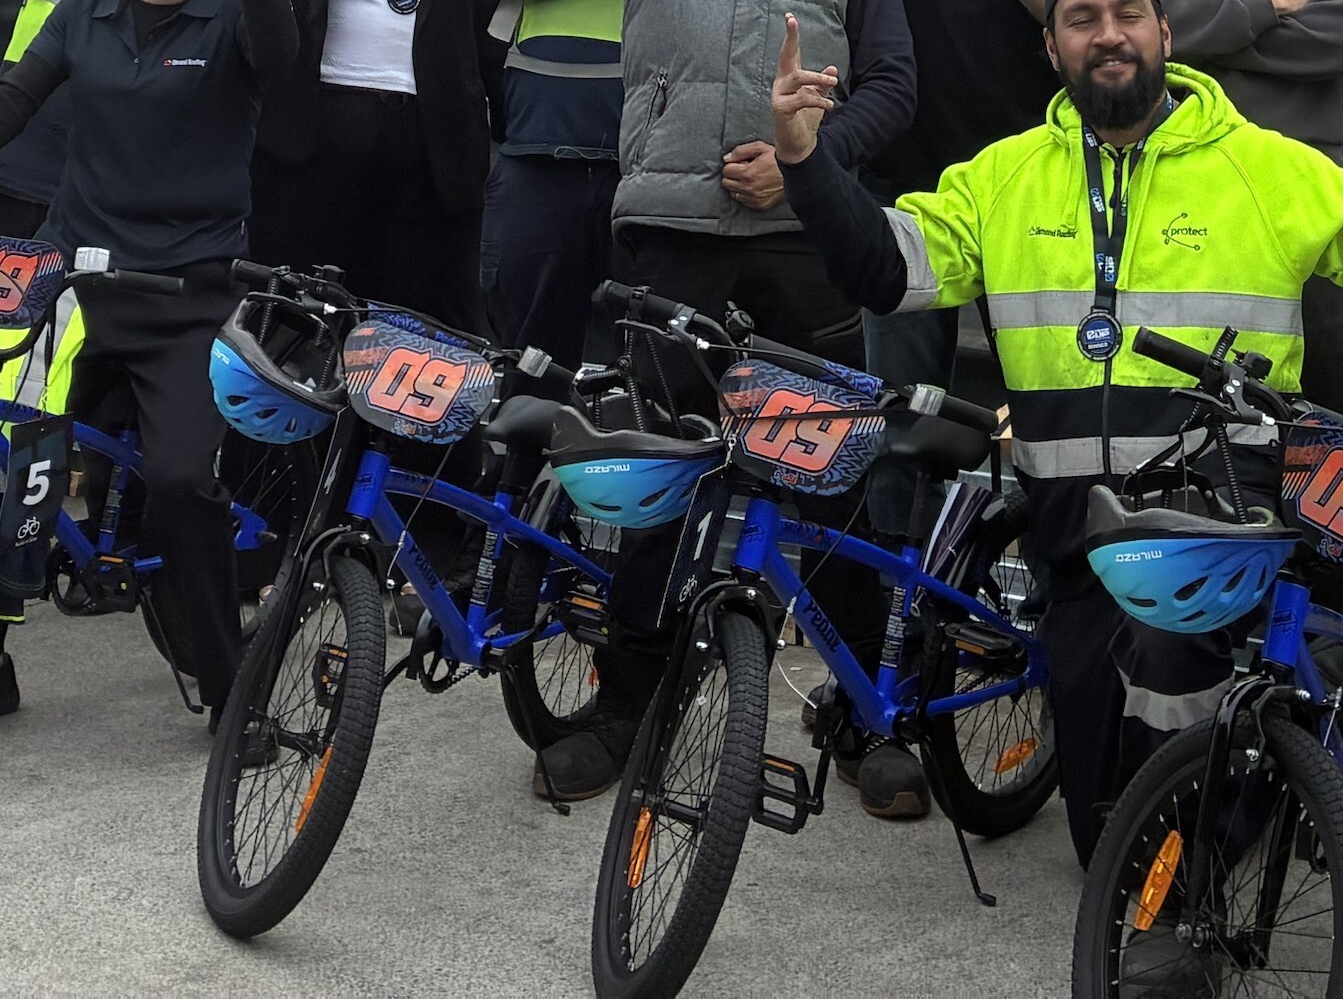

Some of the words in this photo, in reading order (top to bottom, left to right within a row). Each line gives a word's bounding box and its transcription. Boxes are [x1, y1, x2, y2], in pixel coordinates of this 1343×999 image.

[1170, 226, 1208, 238] protect
[366, 347, 468, 423] 09
[744, 388, 860, 473] 09
[22, 459, 51, 506] 5
[584, 463, 630, 474] MILAZO
[692, 511, 713, 561] 1
[1115, 549, 1163, 562] MILAZO
